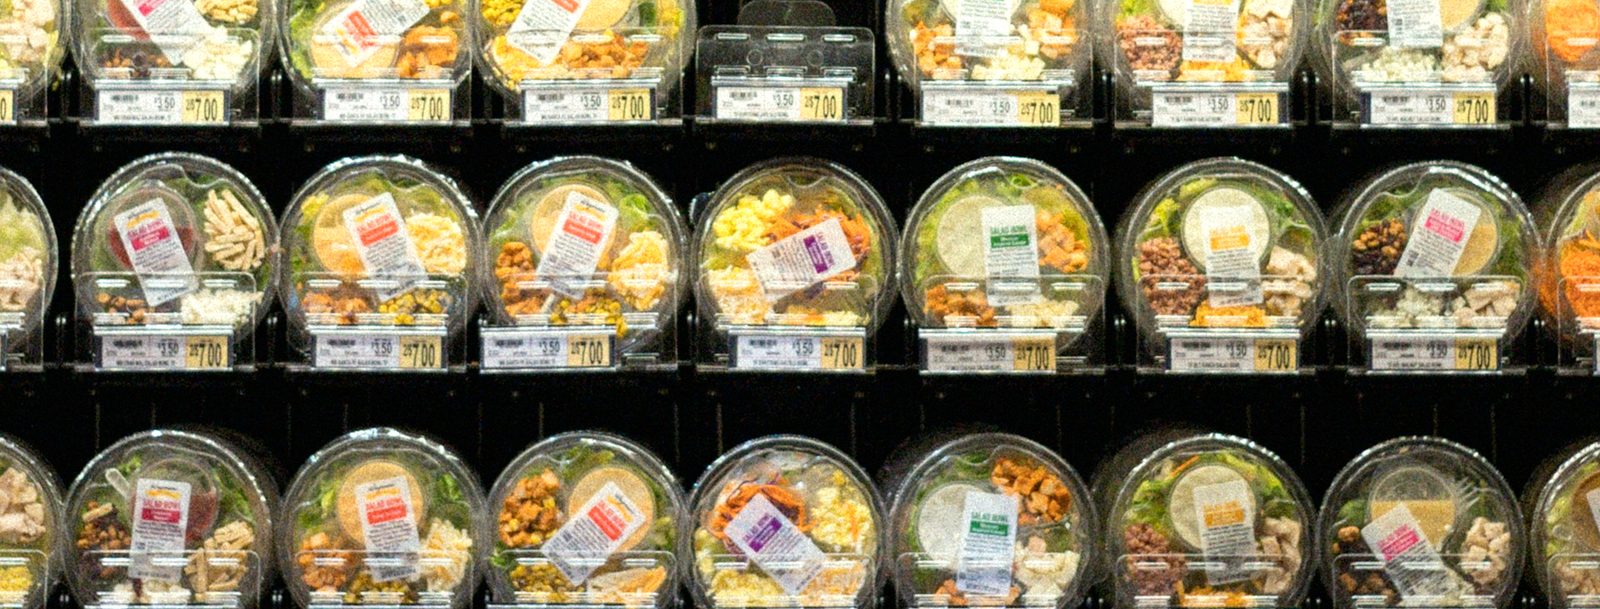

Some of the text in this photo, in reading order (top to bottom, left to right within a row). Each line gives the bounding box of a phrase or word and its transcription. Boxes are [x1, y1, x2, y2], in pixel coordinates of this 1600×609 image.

[990, 226, 1008, 234] SALAD
[814, 231, 836, 267] SALAD BOWL
[142, 498, 181, 509] SALAD BOWL
[364, 496, 403, 510] SALAD BOWL
[971, 511, 1008, 521] SALAD BOWL
[741, 511, 772, 543] SALAD BOWL
